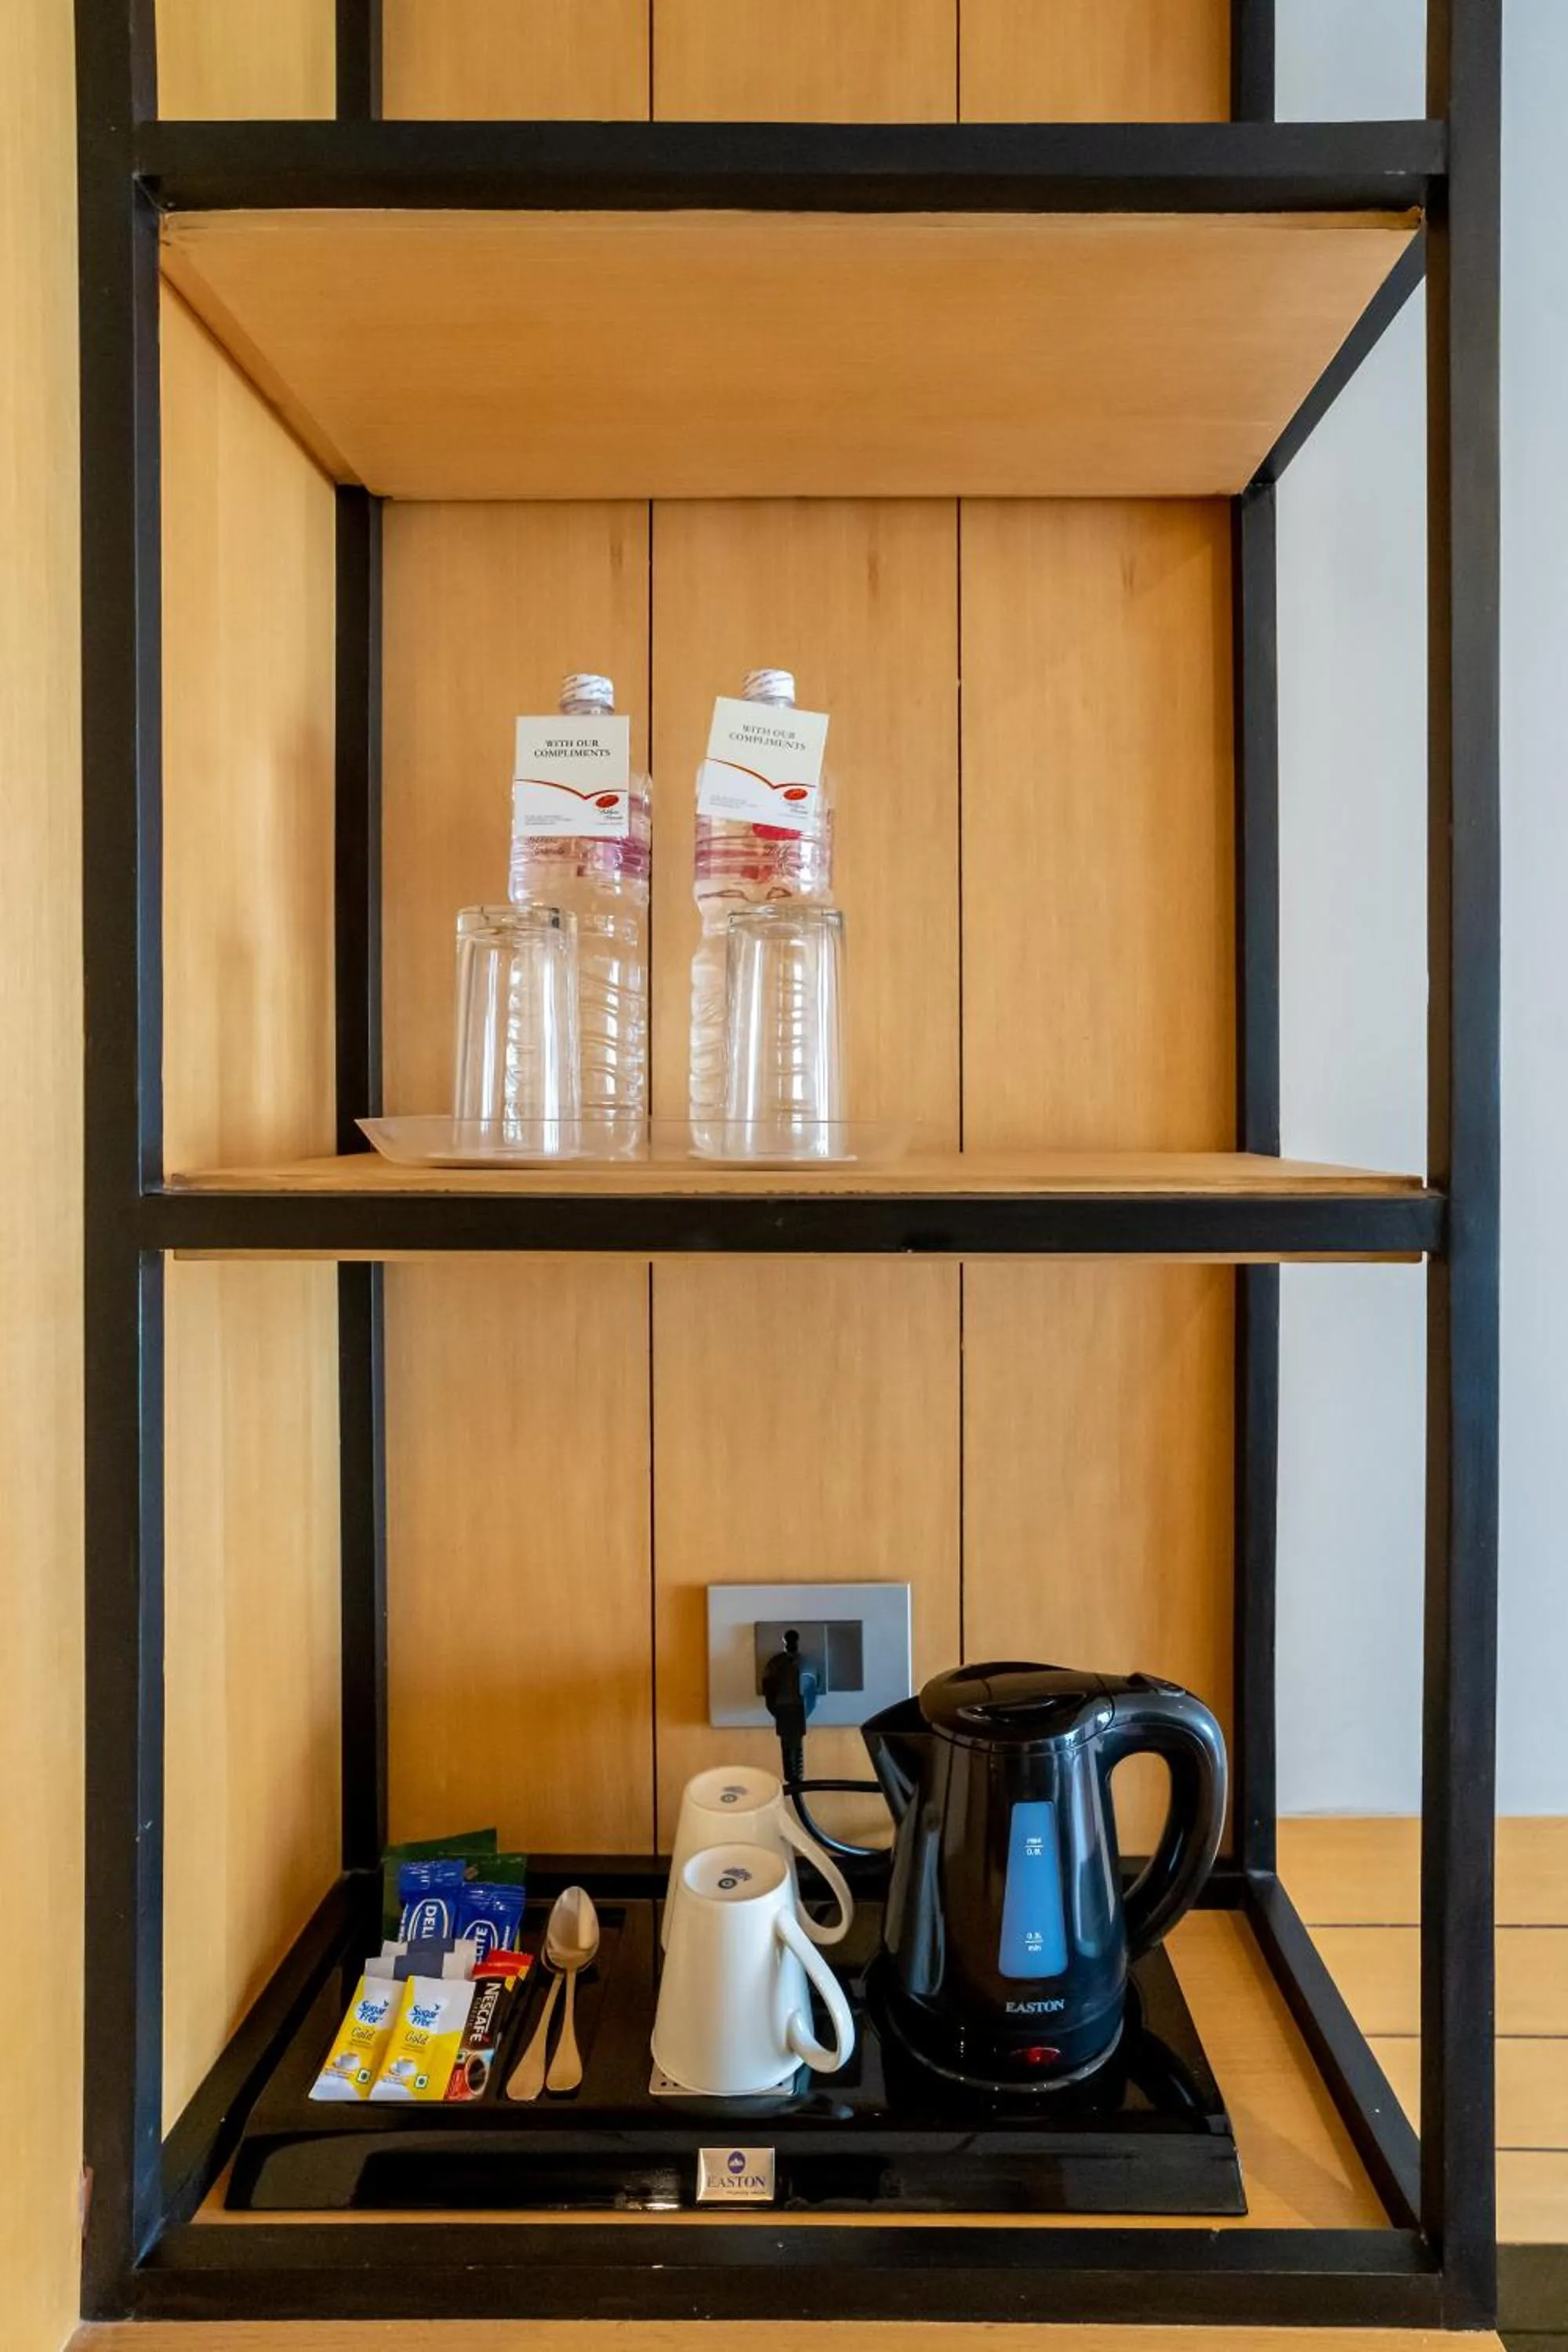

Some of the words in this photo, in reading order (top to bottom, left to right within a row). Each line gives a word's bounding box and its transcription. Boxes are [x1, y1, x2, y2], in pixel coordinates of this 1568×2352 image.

[742, 724, 771, 735] WITH
[773, 728, 796, 739] OUR
[728, 731, 806, 750] COMPLIMENTS
[533, 749, 612, 757] COMPLIMENTS
[475, 1926, 488, 1965] LITE
[358, 2000, 387, 2015] Sugar
[408, 2005, 439, 2019] Sugar
[1005, 1999, 1065, 2013] EASTON
[358, 2012, 379, 2024] Free
[412, 2016, 431, 2027] Free
[350, 2027, 376, 2040] Gold
[405, 2031, 429, 2045] Gold
[707, 2176, 766, 2188] EASTON
